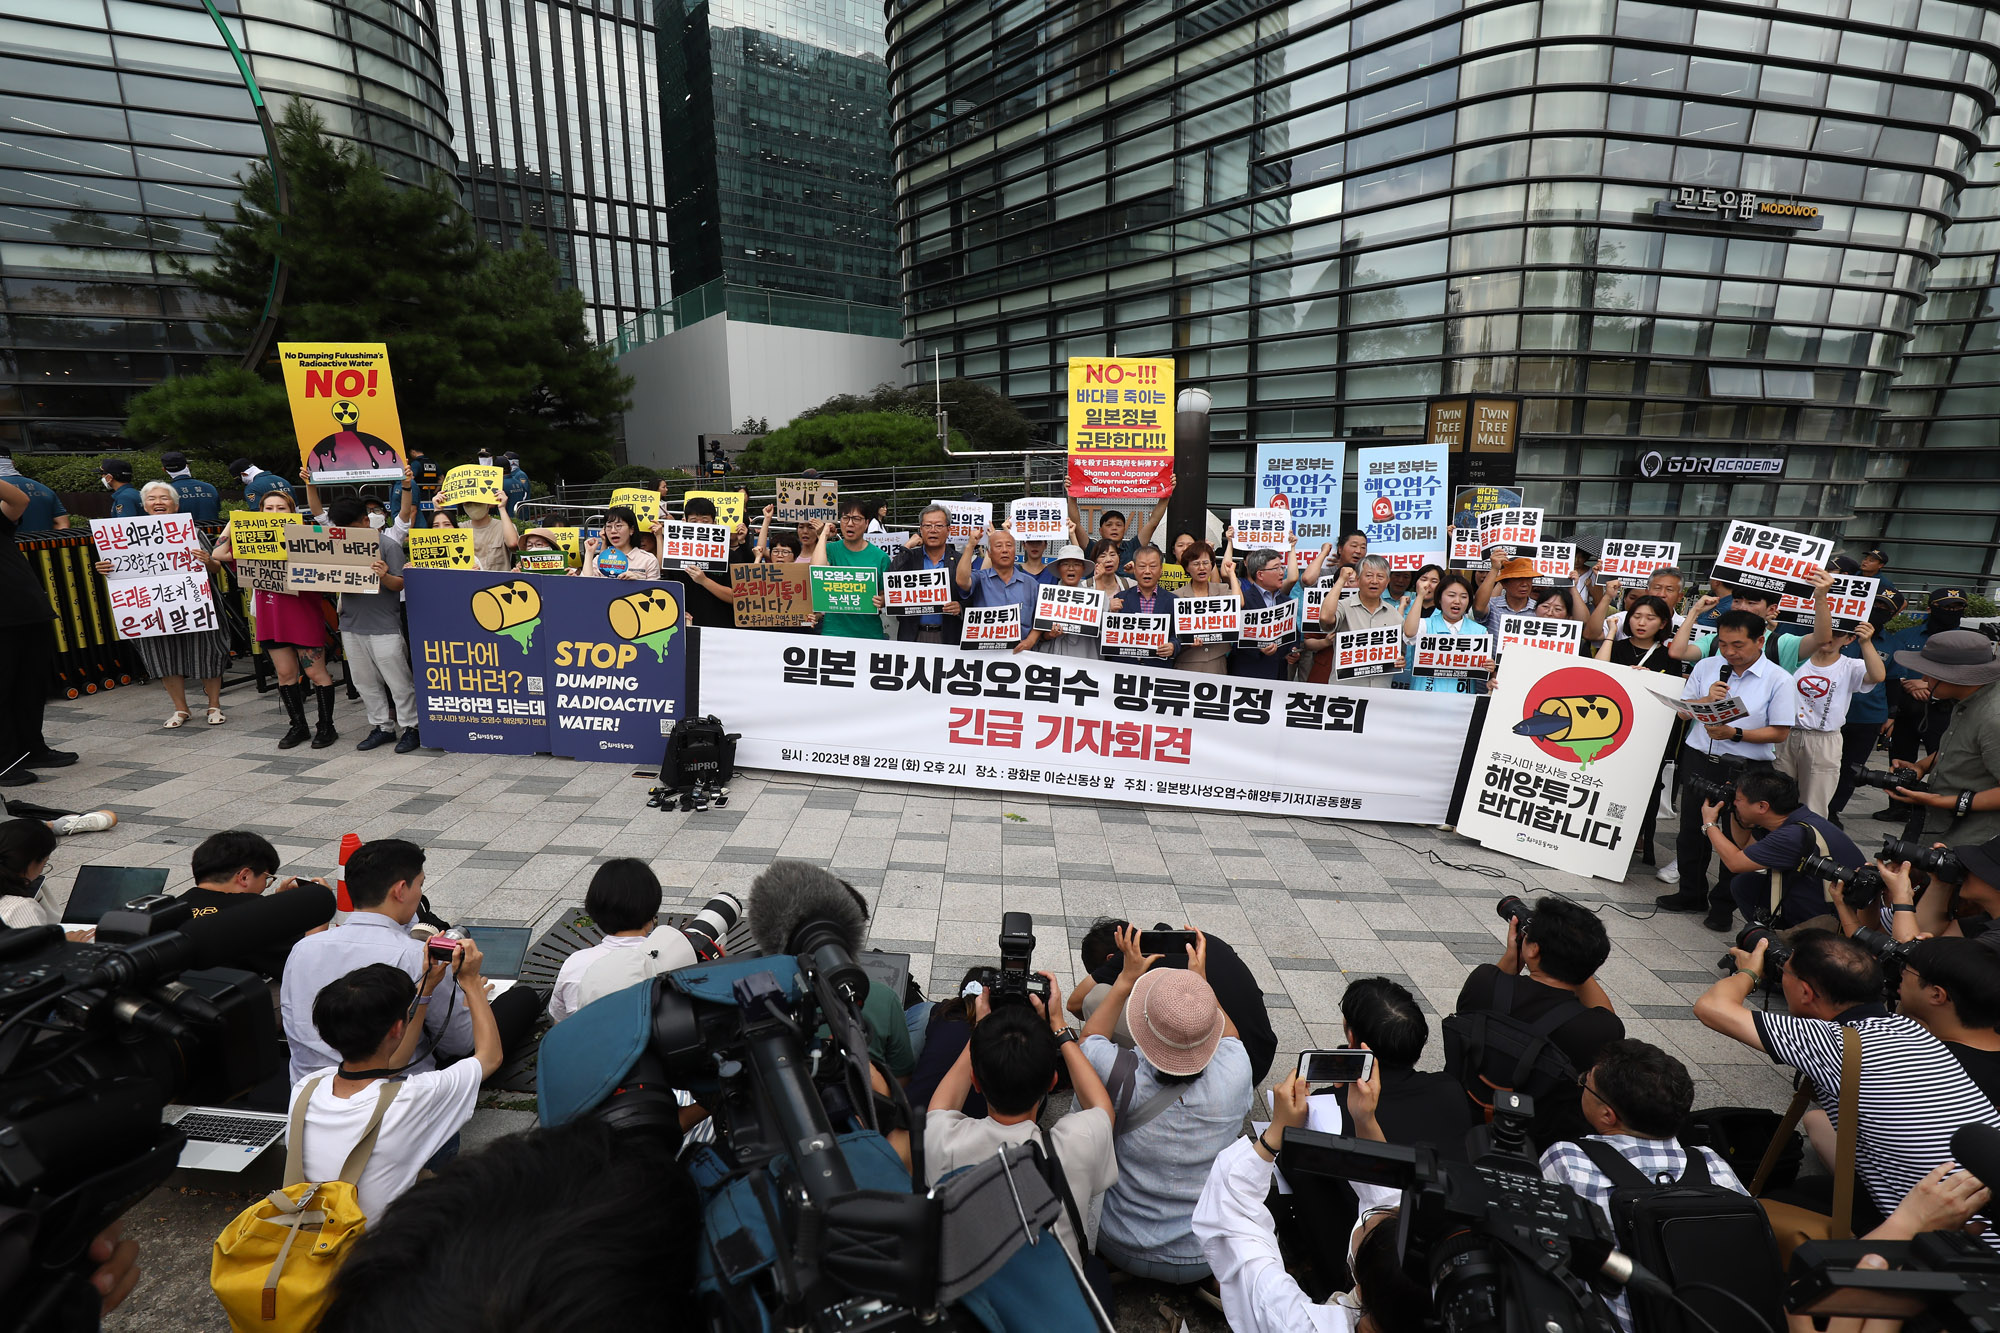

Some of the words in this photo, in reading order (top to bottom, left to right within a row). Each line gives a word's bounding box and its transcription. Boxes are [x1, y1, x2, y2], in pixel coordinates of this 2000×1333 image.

[1760, 202, 1819, 217] MODOWOO
[297, 352, 334, 361] Dumping
[335, 352, 384, 360] Fukushima's
[1086, 364, 1157, 384] NO~!!!
[305, 369, 378, 398] NO!
[1077, 388, 1119, 404] 바다를
[1123, 389, 1166, 405] 죽이는
[1085, 408, 1158, 427] 일본정부
[1437, 409, 1462, 420] TWIN
[1480, 407, 1510, 420] TWIN
[1436, 422, 1461, 433] TREE
[1479, 420, 1508, 433] TREE
[1076, 432, 1166, 450] 규탄한다!!!
[1434, 434, 1459, 445] MALL
[1477, 433, 1507, 446] MALL
[473, 468, 498, 478] 오염수
[1267, 458, 1294, 471] 일본
[1295, 458, 1335, 471] 정부는
[1369, 460, 1396, 474] 일본
[1397, 459, 1438, 473] 정부는
[1667, 456, 1713, 473] GDR
[1716, 460, 1781, 471] ACADEMY
[1083, 469, 1110, 477] Shame
[1121, 469, 1159, 479] Japanese
[1091, 477, 1138, 485] Government
[1139, 477, 1151, 485] for
[1084, 485, 1108, 494] Killing
[1108, 485, 1121, 493] the
[1262, 473, 1338, 494] 핵오염수
[1363, 475, 1442, 497] 핵오염수
[1477, 487, 1499, 496] 바다는
[631, 493, 655, 503] 오염수
[716, 495, 740, 505] 오염수
[1015, 509, 1062, 521] 방류결정
[1291, 497, 1328, 518] 방류
[1394, 499, 1433, 521] 방류
[234, 519, 268, 529] 후쿠시마
[1015, 520, 1062, 533] 철회하라
[1237, 519, 1285, 532] 방류결정
[1480, 511, 1538, 531] 방류일정
[235, 530, 279, 544] 해양투기
[328, 527, 346, 541] 왜
[411, 535, 441, 546] 후쿠시마
[442, 533, 469, 543] 오염수
[667, 524, 726, 543] 방류일정
[1237, 531, 1285, 544] 철회하라
[1481, 527, 1536, 547] 철회하라
[237, 545, 256, 555] 절대
[257, 543, 279, 554] 안돼!
[288, 538, 334, 555] 바다에
[343, 542, 380, 558] 버려?
[667, 541, 726, 558] 철회하라
[1606, 541, 1675, 560] 해양투기
[1731, 526, 1826, 561] 해양투기
[412, 546, 450, 560] 해양투기
[238, 565, 256, 577] THE
[1723, 545, 1818, 582] 결사반대
[290, 566, 342, 585] 보관하면
[734, 565, 784, 583] 바다는
[812, 570, 824, 581] 핵
[824, 570, 854, 582] 오염수
[855, 571, 875, 583] 투기
[887, 571, 947, 589] 해양투기
[252, 578, 284, 592] OCEAN
[733, 580, 807, 601] 쓰레기통이
[822, 582, 867, 593] 규탄한다!
[111, 586, 152, 609] 트리튬
[152, 581, 188, 602] 기준치
[828, 594, 861, 606] 녹색당
[889, 588, 948, 604] 결사반대
[1041, 586, 1100, 608] 해양투기
[737, 598, 793, 614] 아니다!
[1039, 602, 1098, 624] 결사반대
[1178, 598, 1237, 616] 해양투기
[1243, 600, 1295, 626] 해양투기
[168, 602, 216, 633] 말라
[750, 614, 774, 626] 후쿠시마
[967, 607, 1019, 625] 해양투기
[1106, 615, 1167, 632] 해양투기
[1178, 614, 1237, 632] 결사반대
[965, 625, 1019, 640] 결사반대
[1243, 621, 1294, 639] 결사반대
[1504, 618, 1578, 640] 해양투기
[1105, 630, 1165, 647] 결사반대
[1340, 628, 1399, 650] 방류일정
[1420, 636, 1489, 653] 해양투기
[424, 640, 499, 667] 바다에
[554, 641, 638, 670] STOP
[1340, 646, 1399, 665] 철회하라
[1418, 652, 1487, 669] 결사반대
[426, 667, 452, 692] 왜
[458, 668, 523, 694] 버려?
[555, 673, 639, 692] DUMPING
[783, 646, 856, 688] 일본
[869, 652, 1100, 707] 방사성오염수
[1112, 673, 1274, 726] 방류일정
[1285, 690, 1369, 734] 철회
[427, 696, 494, 714] 보관하면
[497, 698, 546, 716] 되는데
[556, 695, 675, 714] RADIOACTIVE
[429, 714, 457, 723] 후쿠시마
[458, 715, 480, 724] 방사능
[480, 716, 502, 725] 오염수
[503, 717, 531, 726] 해양투기
[532, 718, 547, 726] 반대
[558, 715, 620, 732] WATER!
[948, 706, 1024, 750] 긴급
[1035, 714, 1193, 765] 기자회견
[1490, 751, 1534, 771] 후쿠시마
[1535, 762, 1568, 780] 방사능
[1569, 772, 1604, 789] 오염수
[781, 748, 803, 762] 일시
[811, 750, 851, 767] 2023년
[853, 754, 871, 768] 8월
[874, 756, 899, 771] 22일
[901, 757, 921, 773] (화)
[923, 759, 946, 774] 오후
[948, 762, 967, 776] 2시
[975, 764, 996, 778] 장소
[1007, 766, 1041, 783] 광화문
[1044, 770, 1101, 788] 이순신동상
[1104, 776, 1115, 789] 앞
[1124, 778, 1147, 792] 주최
[1156, 780, 1363, 810] 일본방사성오염수해양투기저지공동행동
[1484, 764, 1601, 817] 해양투기
[1477, 788, 1623, 851] 반대합니다
